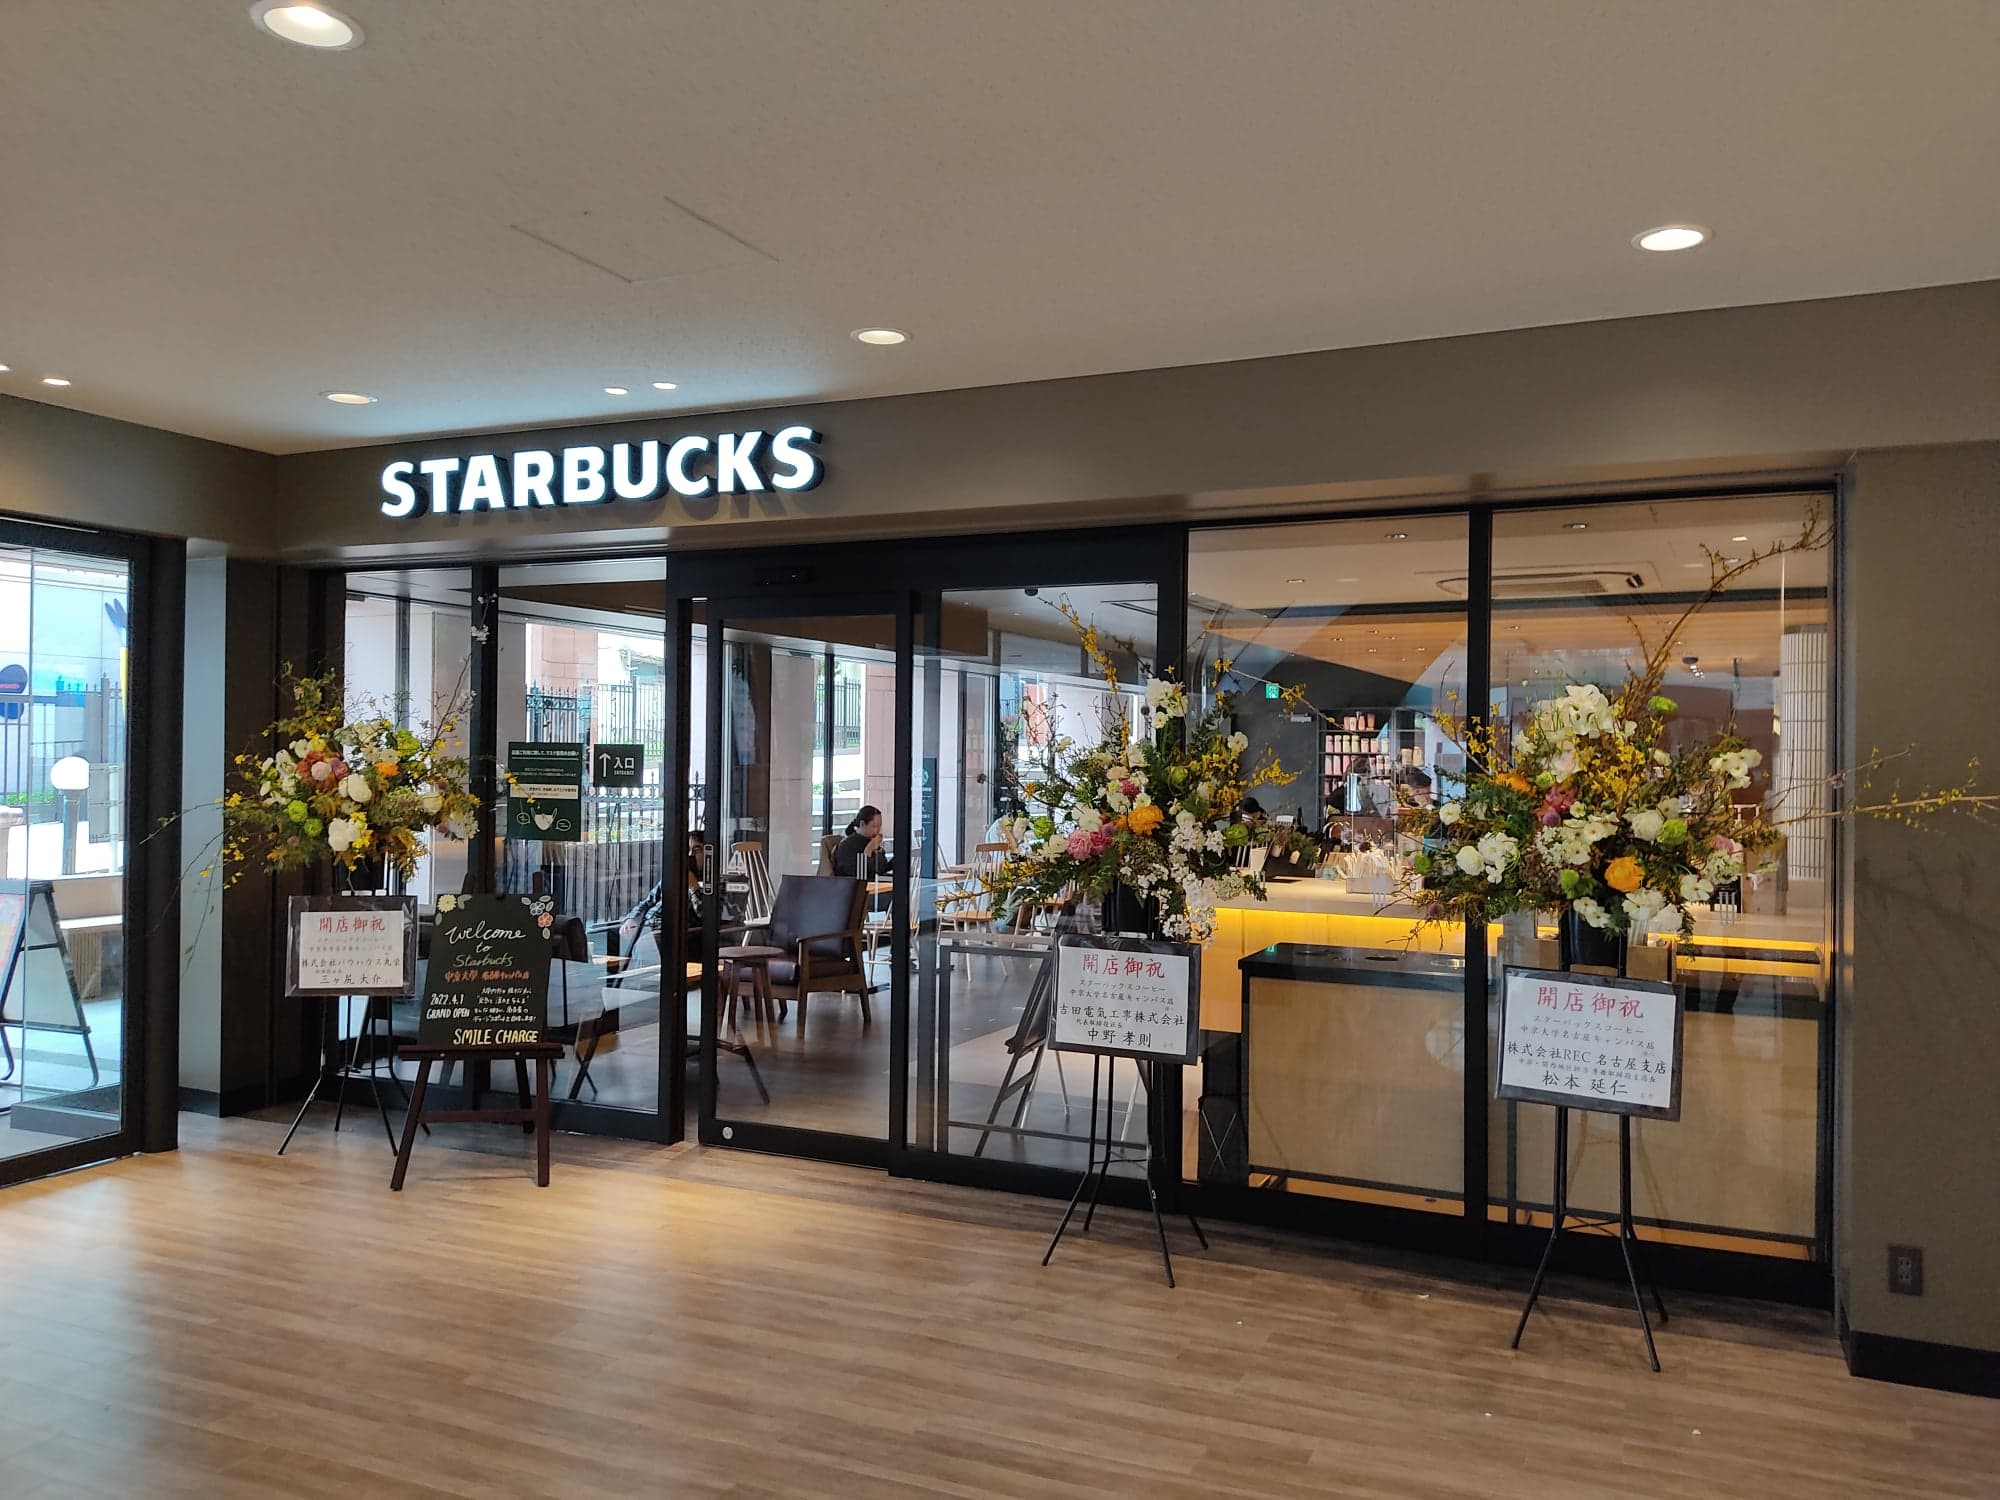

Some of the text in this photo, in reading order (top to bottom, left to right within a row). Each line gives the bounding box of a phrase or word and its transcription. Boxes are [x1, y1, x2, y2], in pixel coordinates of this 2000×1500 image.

[380, 425, 819, 518] STARBUCKS
[613, 757, 635, 769] 入口
[319, 916, 386, 934] 開店御祝
[475, 942, 493, 953] to
[1082, 953, 1165, 979] 開店御祝
[430, 993, 465, 1006] 2022.4.1
[1537, 986, 1645, 1019] 開店御祝
[426, 1008, 452, 1020] GRAND
[452, 1007, 471, 1018] OPEN
[1059, 1004, 1185, 1026] 吉田電気工事株式会社
[453, 1028, 539, 1045] SMILE CHARGE
[1087, 1027, 1117, 1044] 中野
[1595, 1054, 1668, 1075] 名古屋支店
[1542, 1070, 1582, 1091] 松本
[1589, 1078, 1629, 1096] 延仁
